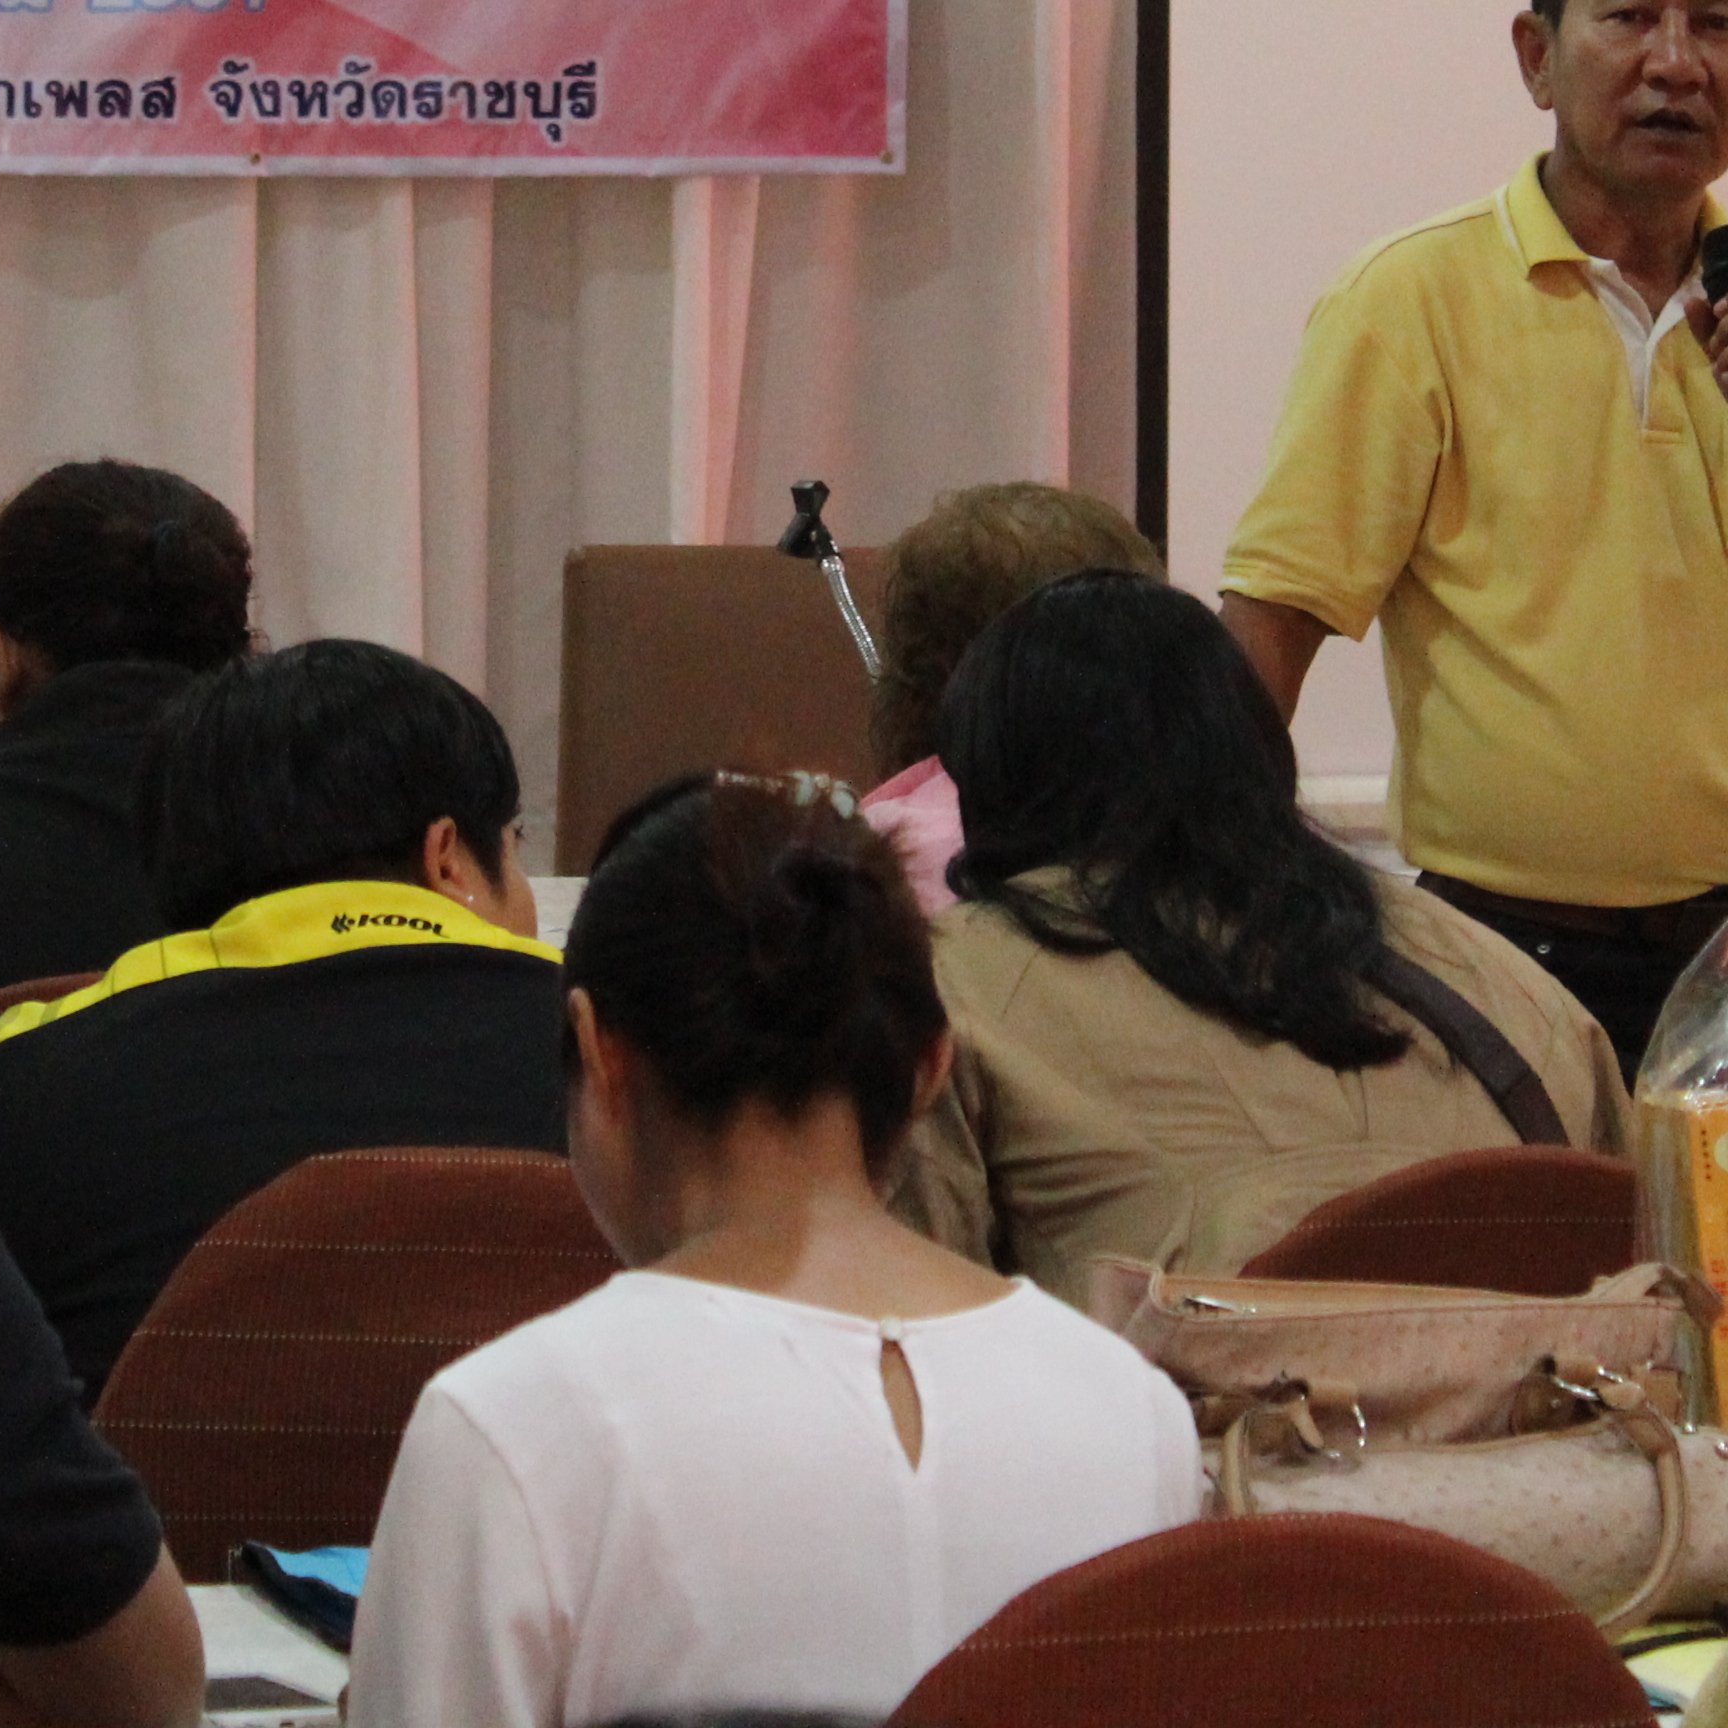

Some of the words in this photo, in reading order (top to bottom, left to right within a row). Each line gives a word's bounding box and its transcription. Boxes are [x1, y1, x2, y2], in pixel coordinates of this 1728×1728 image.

[210, 60, 599, 143] จังหวัดราชบุรี
[357, 914, 450, 938] KOOL
